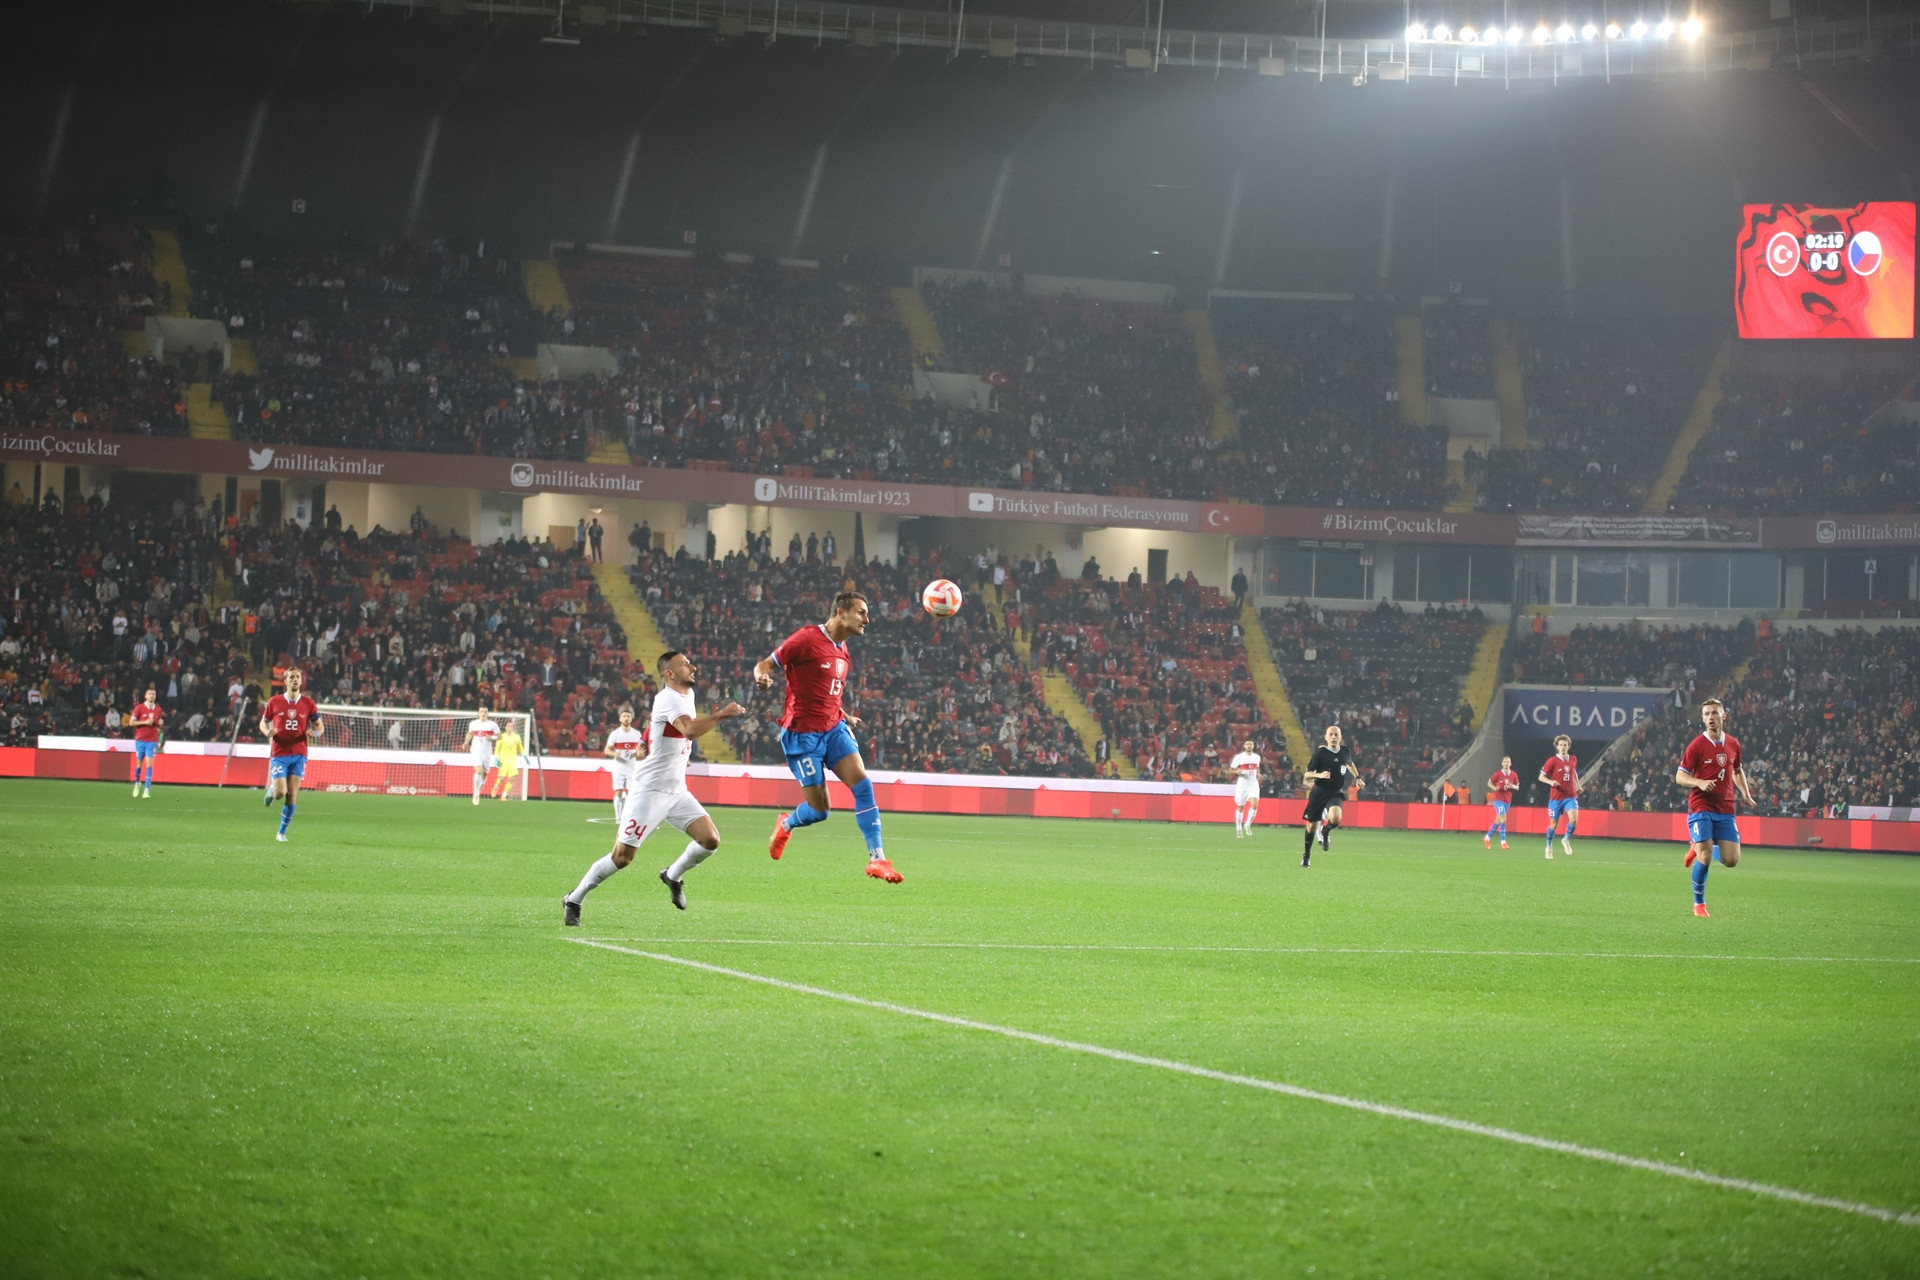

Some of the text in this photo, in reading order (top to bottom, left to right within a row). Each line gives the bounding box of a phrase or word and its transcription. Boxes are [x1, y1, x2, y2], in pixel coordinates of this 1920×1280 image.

[1806, 234, 1844, 249] 02:19
[1810, 252, 1839, 271] 0-0
[0, 433, 121, 456] izimÇocuklar
[274, 453, 385, 475] millitakimlar
[535, 469, 643, 491] millitakimlar
[778, 485, 911, 506] MilliTakimlar1923
[995, 497, 1189, 524] Türkiye Futbol Federasyonu
[1323, 514, 1458, 536] #BizimÇocuklar
[829, 678, 842, 695] 13
[285, 720, 298, 731] 22
[797, 757, 817, 778] 13
[1563, 773, 1570, 782] 21
[1718, 769, 1726, 781] 4
[624, 819, 647, 840] 24
[1693, 822, 1700, 835] 4
